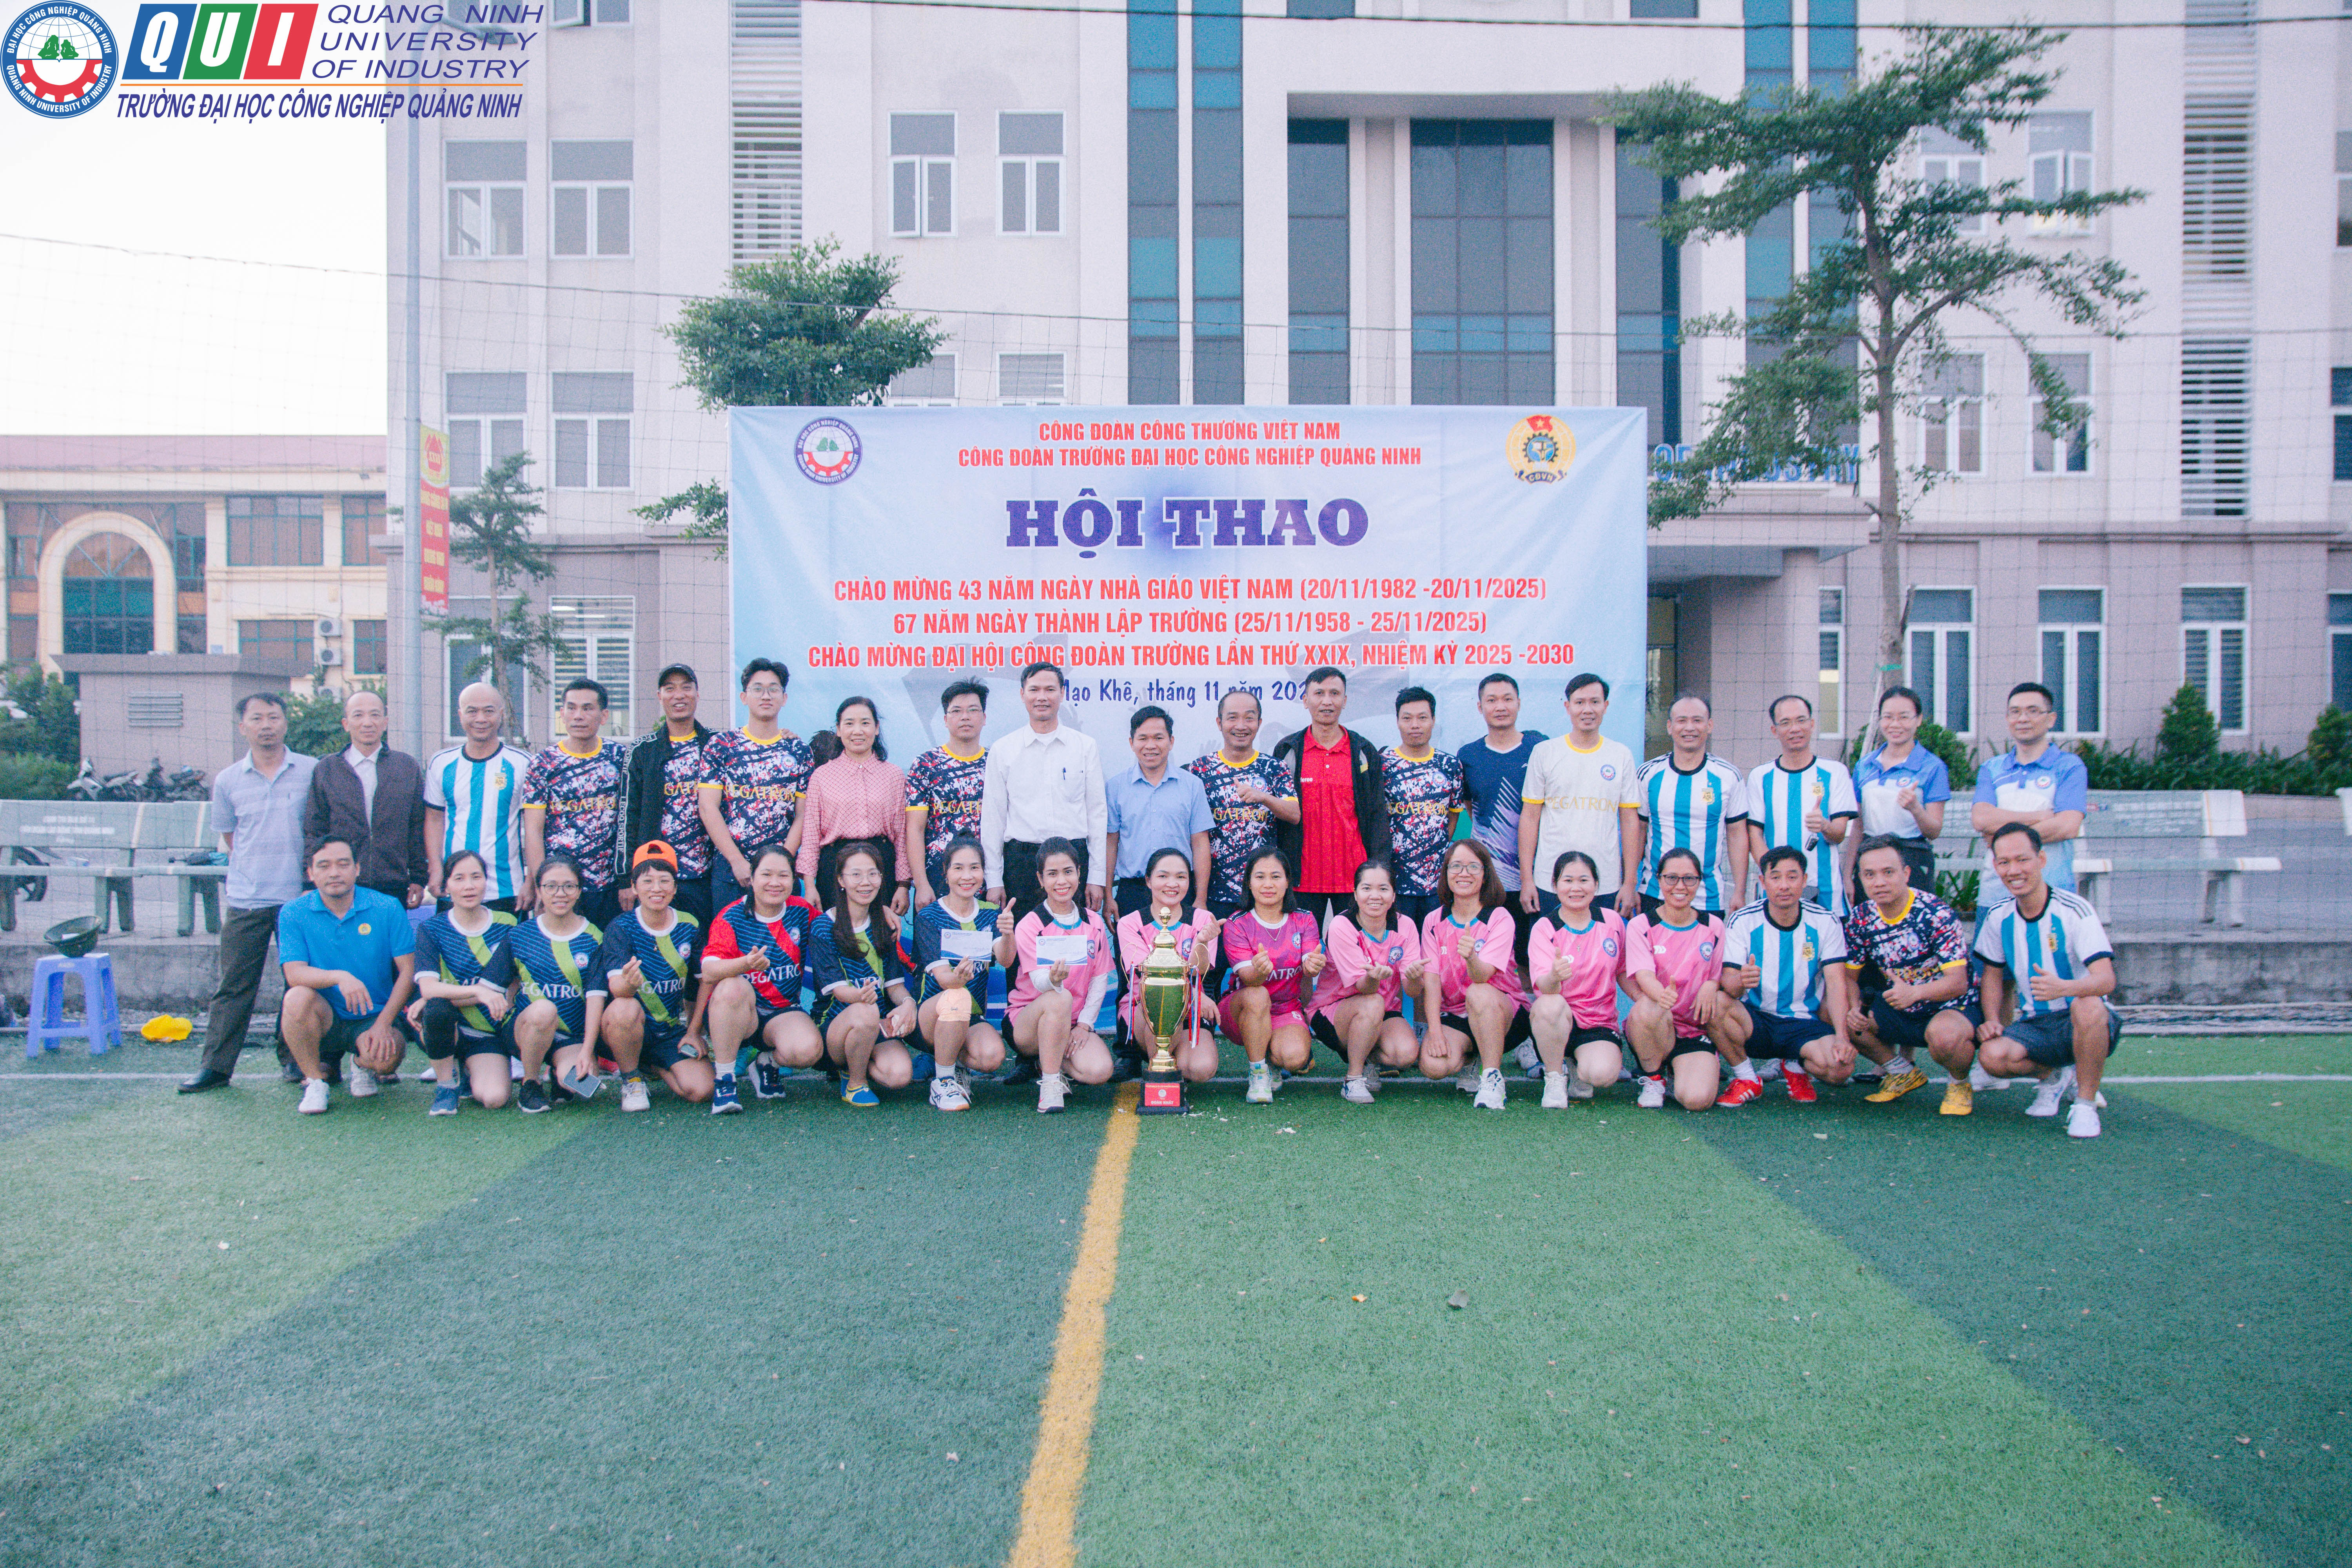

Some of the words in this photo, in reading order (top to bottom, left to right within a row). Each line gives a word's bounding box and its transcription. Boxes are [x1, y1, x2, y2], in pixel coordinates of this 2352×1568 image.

[1039, 419, 1084, 441] CÔNG
[1090, 421, 1134, 441] ĐOÀN
[1140, 419, 1185, 441] CÔNG
[1191, 419, 1258, 440] THƯƠNG
[1263, 419, 1298, 443] VIỆT
[1304, 422, 1340, 440] NAM
[958, 446, 1004, 467] CÔNG
[1009, 445, 1053, 466] ĐOÀN
[1059, 445, 1125, 466] TRƯỜNG
[1131, 448, 1159, 469] ĐẠI
[1165, 448, 1199, 469] HỌC
[1205, 445, 1250, 466] CÔNG
[1256, 445, 1314, 469] NGHIỆP
[1320, 443, 1376, 467] QUẢNG
[1382, 447, 1421, 465] NINH
[1006, 488, 1145, 559] HỘI
[1163, 497, 1368, 548] THAO
[834, 575, 886, 601] CHÀO
[893, 575, 952, 601] MỪNG
[958, 579, 982, 601] 43
[988, 573, 1034, 600] NĂM
[1041, 574, 1093, 601] NGÀY
[1100, 574, 1141, 600] NHÀ
[1147, 574, 1193, 600] GIÁO
[1199, 574, 1241, 604] VIỆT
[1247, 578, 1293, 599] NAM
[1301, 578, 1416, 601] (20/11/1982
[1423, 577, 1546, 601] -20/11/2025)
[893, 613, 917, 634] 67
[924, 608, 969, 634] NĂM
[976, 608, 1028, 633] NGÀY
[1034, 608, 1100, 633] THÀNH
[1106, 608, 1143, 638] LẬP
[1149, 607, 1227, 633] TRƯỜNG
[1234, 611, 1350, 634] (25/11/1958
[1371, 611, 1487, 634] 25/11/2025)
[808, 642, 860, 668] CHÀO
[867, 641, 926, 667] MỪNG
[931, 646, 965, 672] ĐẠI
[971, 641, 1004, 672] HỘI
[1011, 641, 1064, 667] CÔNG
[1070, 640, 1125, 666] ĐOÀN
[1131, 640, 1210, 666] TRƯỜNG
[1216, 637, 1254, 666] LẦN
[1260, 640, 1300, 666] THỨ
[1304, 644, 1356, 668] XXIX,
[1363, 639, 1427, 670] NHIỆM
[1434, 640, 1459, 665] KỲ
[1465, 644, 1512, 665] 2025
[1519, 644, 1574, 665] -2030
[1100, 679, 1139, 705] Khê,
[1147, 678, 1196, 708] tháng
[1204, 681, 1219, 701] 11
[1271, 680, 1307, 701] 202
[551, 797, 615, 812] PEGATRO
[725, 784, 795, 802] PEGATRON
[1546, 796, 1617, 813] PEGATRON
[1214, 808, 1268, 822] GATRON
[1387, 801, 1448, 816] EGATRON
